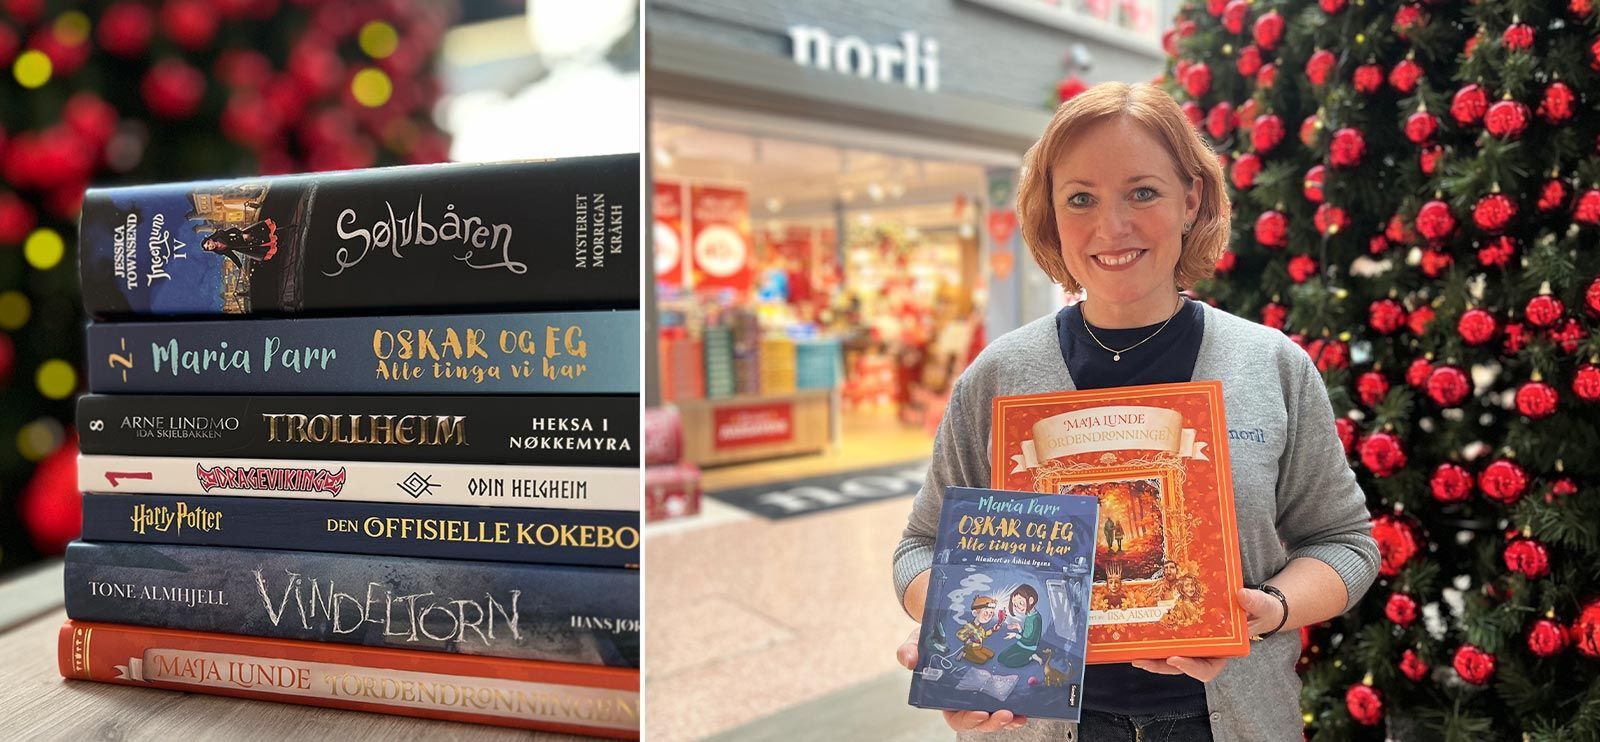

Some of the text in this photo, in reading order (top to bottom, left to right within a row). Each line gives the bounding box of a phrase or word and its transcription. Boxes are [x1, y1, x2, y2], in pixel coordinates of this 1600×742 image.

[788, 25, 940, 92] norli
[321, 194, 528, 276] Sølvbåren
[575, 194, 588, 269] MYSTERIET
[593, 193, 605, 268] MORRIGAN
[610, 204, 623, 255] KRÅKH
[114, 224, 126, 277] JESSICA
[127, 213, 138, 290] TOWNSEND
[174, 238, 187, 260] IV
[152, 336, 337, 376] Maria Parr
[373, 325, 587, 361] OSKAR OG EG
[375, 355, 587, 384] Alle tinga vi har
[89, 419, 105, 431] 8
[120, 416, 239, 432] ARNE LINDMO
[136, 429, 222, 439] IDA SKJELBAKKEN
[262, 413, 470, 446] TROLLHEIM
[532, 417, 608, 432] HEKSA I
[1064, 414, 1145, 431] MAJA LUNDE
[1229, 428, 1265, 443] norli
[509, 436, 631, 451] NØKKEMYRA
[1044, 424, 1176, 450] ORDENDRONNINGEN
[104, 470, 153, 488] 1
[468, 477, 587, 500] ODIN HELGHEIM
[130, 501, 223, 537] Harry Potter
[978, 495, 1060, 515] Maria Parr
[327, 516, 640, 549] DEN OFFISIELLE KOKEBO
[958, 515, 1073, 542] OSKAR OG EG
[957, 536, 1071, 556] Alle tinga vi har
[88, 581, 229, 609] TONE ALMHJELL
[253, 564, 522, 647] VINDELTORN
[571, 615, 612, 631] HANS
[153, 655, 223, 683] MAJA
[228, 661, 311, 690] LUNDE
